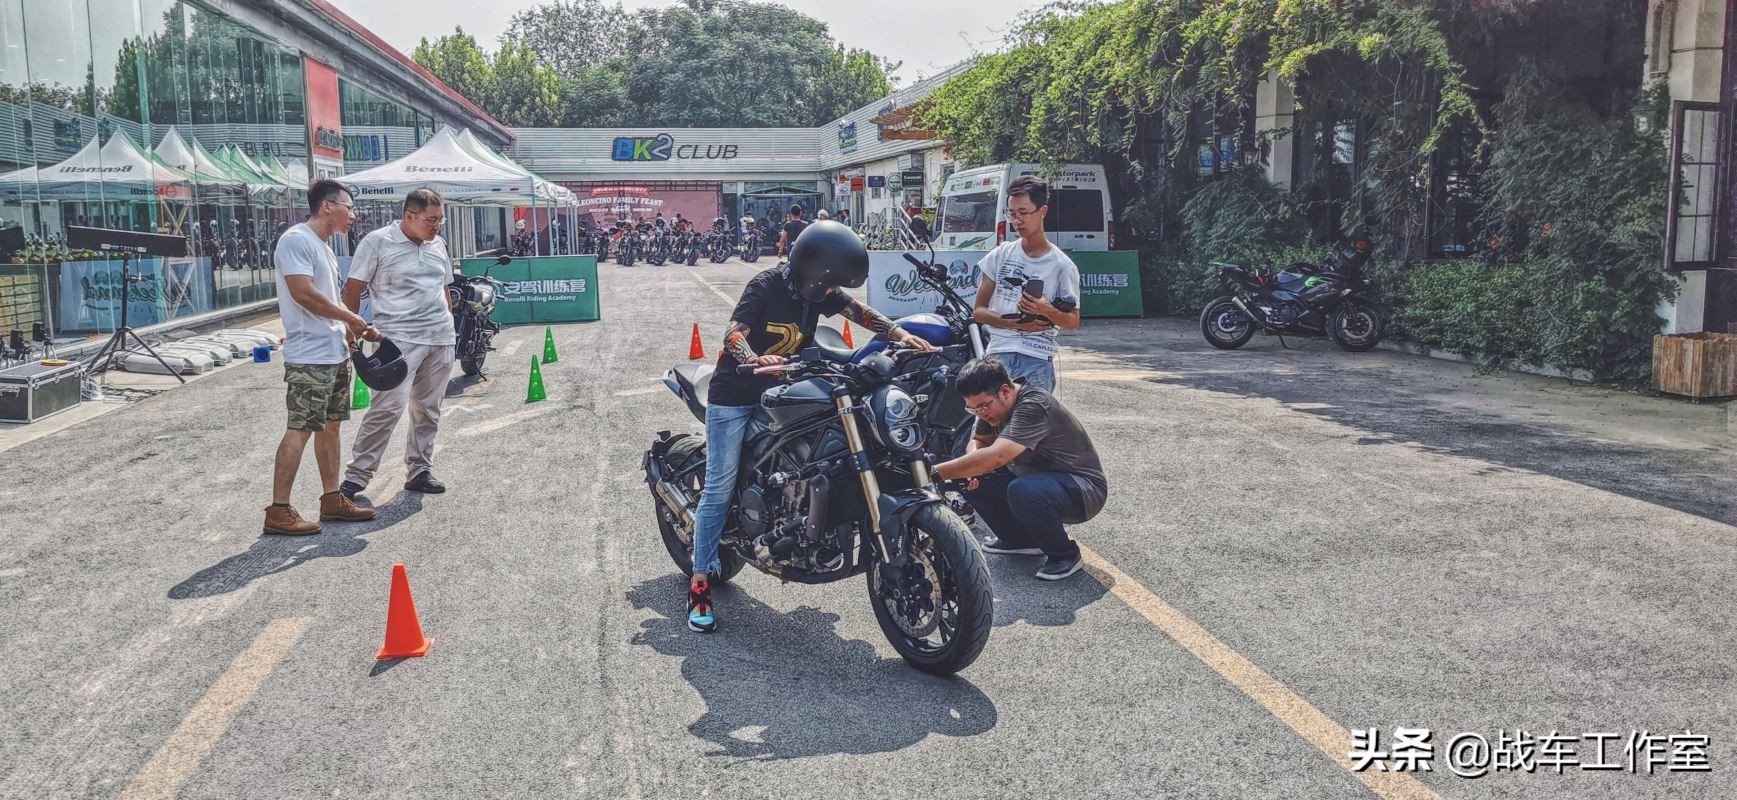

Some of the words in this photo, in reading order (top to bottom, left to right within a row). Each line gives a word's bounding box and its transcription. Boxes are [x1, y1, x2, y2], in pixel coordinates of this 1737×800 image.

[613, 133, 674, 161] BK2
[677, 144, 738, 159] CLUB
[404, 165, 473, 173] Benelli
[361, 187, 394, 195] Benelli
[577, 197, 612, 207] LEONCINO
[613, 196, 640, 204] FAMILY
[640, 198, 664, 207] FEAST
[1079, 273, 1129, 288] 训练营
[504, 279, 586, 295] 安驾训练营
[504, 295, 526, 303] Benelli
[526, 294, 547, 303] Riding
